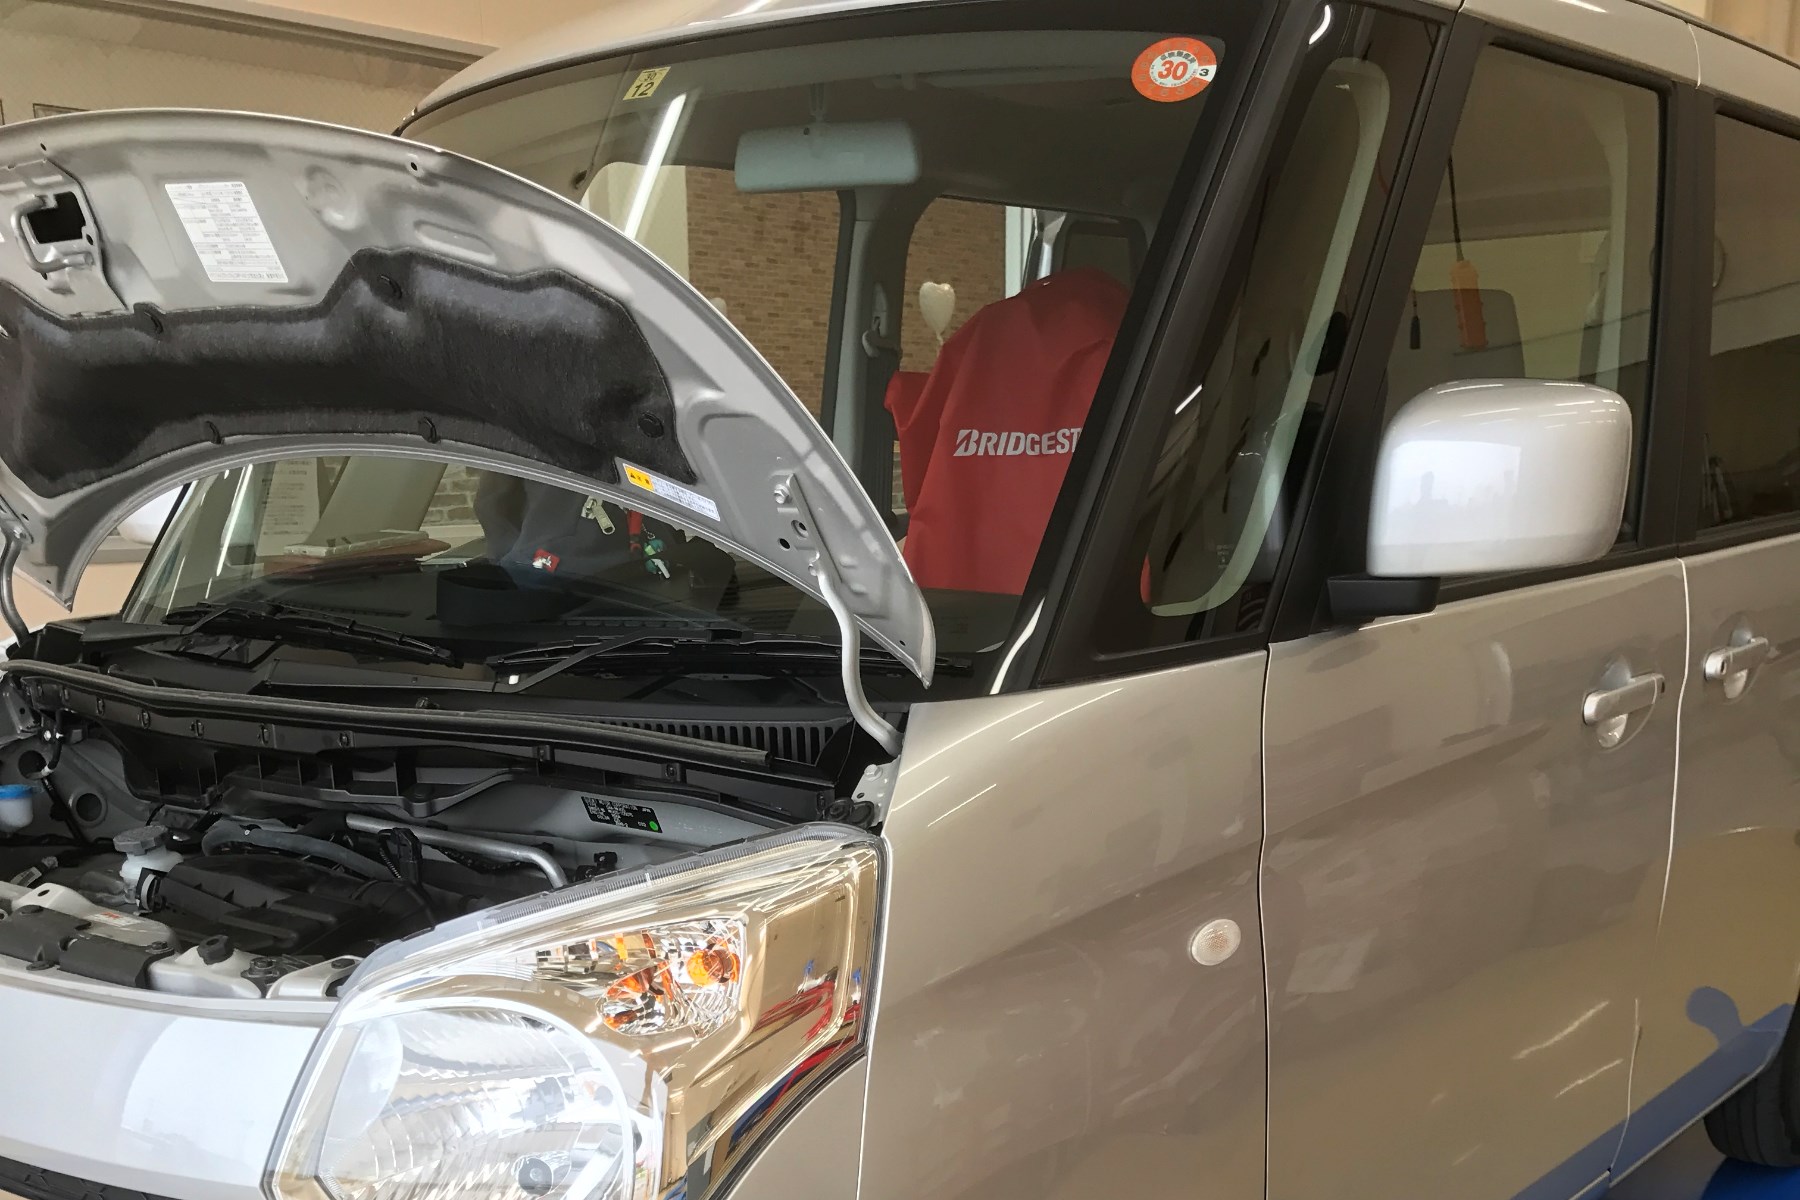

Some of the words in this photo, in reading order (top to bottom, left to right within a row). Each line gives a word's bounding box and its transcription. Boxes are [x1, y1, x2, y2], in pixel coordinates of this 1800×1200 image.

[1157, 60, 1189, 81] 30
[1199, 68, 1210, 77] 3
[631, 82, 655, 98] 12
[953, 427, 1083, 457] BRIDGEST
